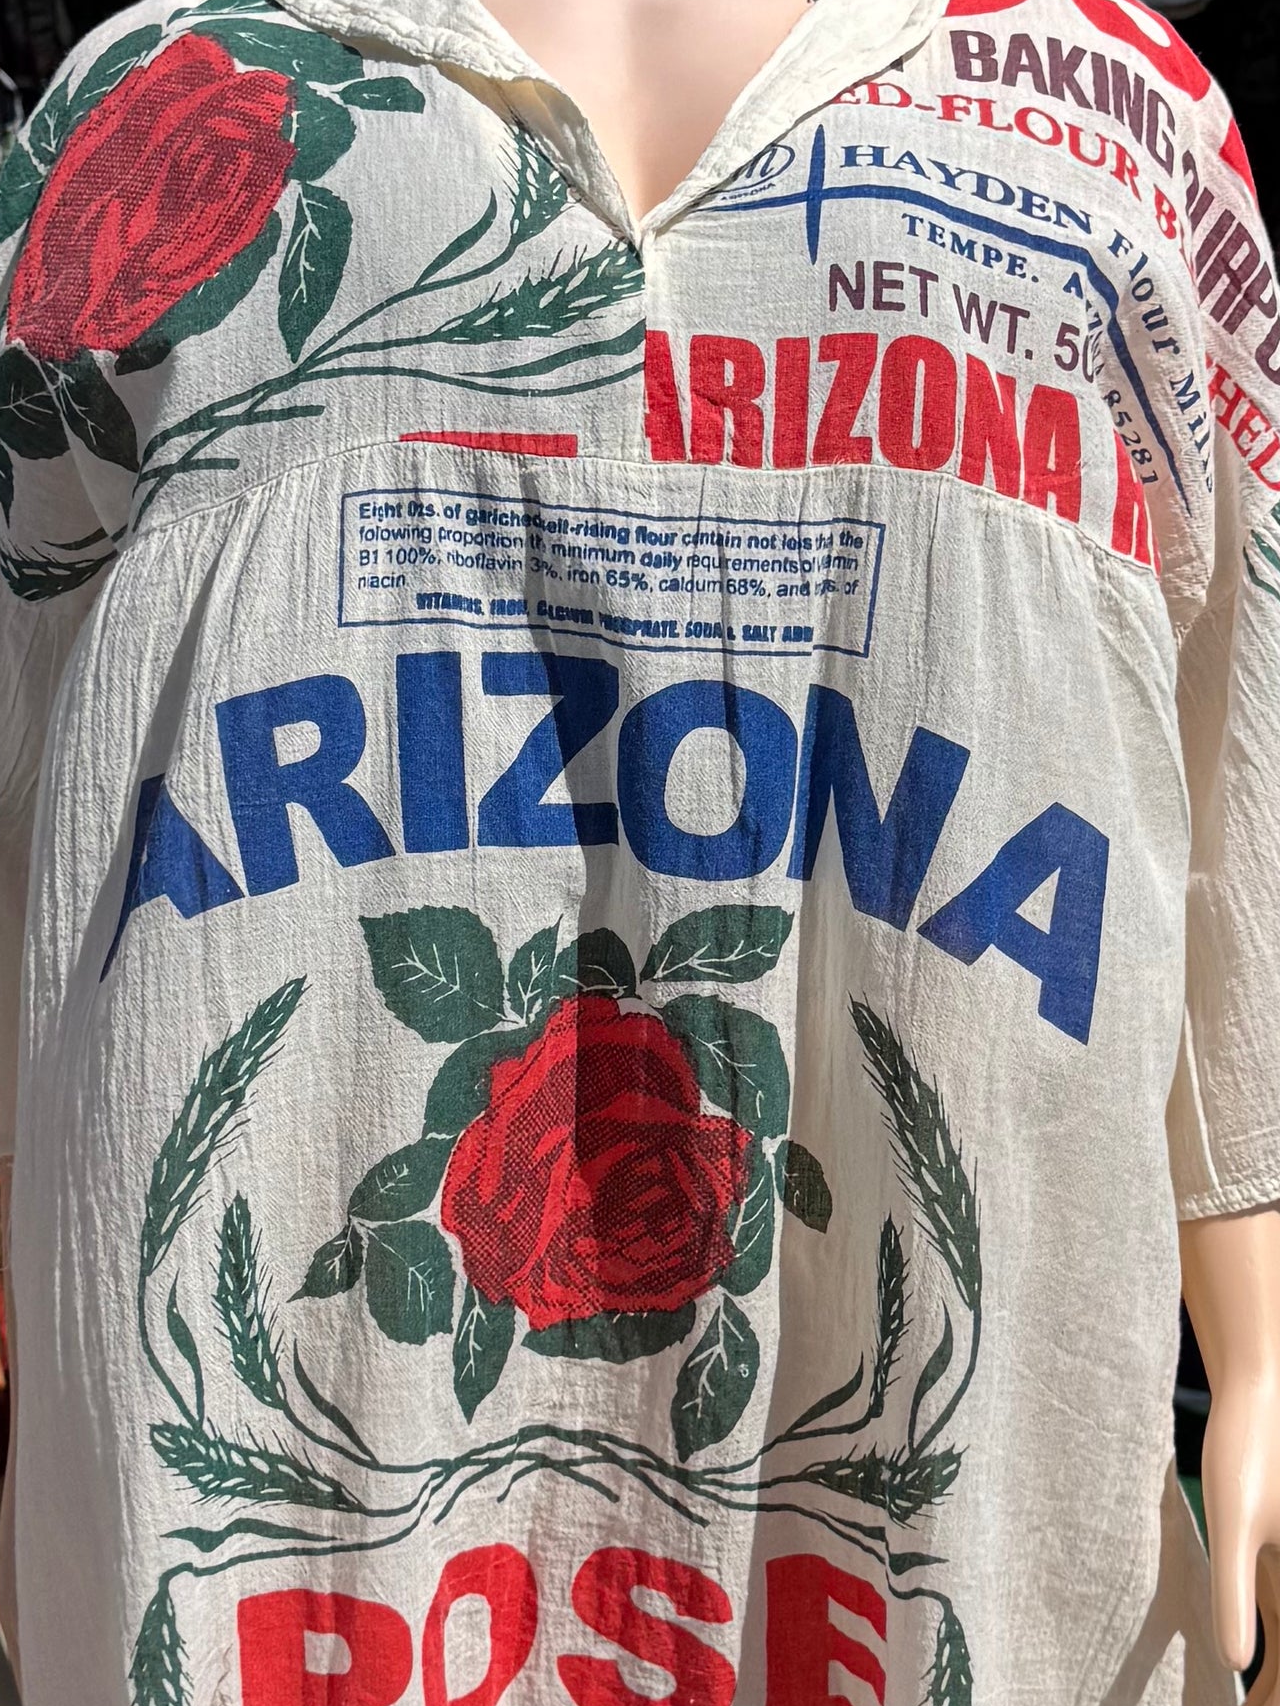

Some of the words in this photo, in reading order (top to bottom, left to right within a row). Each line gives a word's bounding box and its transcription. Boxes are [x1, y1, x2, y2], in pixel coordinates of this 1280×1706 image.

[949, 29, 1176, 178] BAKING
[840, 144, 1093, 235] HAYDEN
[1107, 229, 1181, 357] Flour
[901, 212, 1040, 284] TEMPE.
[828, 260, 939, 318] NET
[952, 282, 1035, 361] WT.
[443, 503, 462, 520] of
[634, 525, 678, 547] flour
[747, 534, 778, 550] not
[839, 530, 864, 549] the
[551, 543, 636, 566] minimum
[567, 566, 601, 585] iron
[775, 580, 812, 598] and
[98, 651, 1112, 1047] ARIZONA
